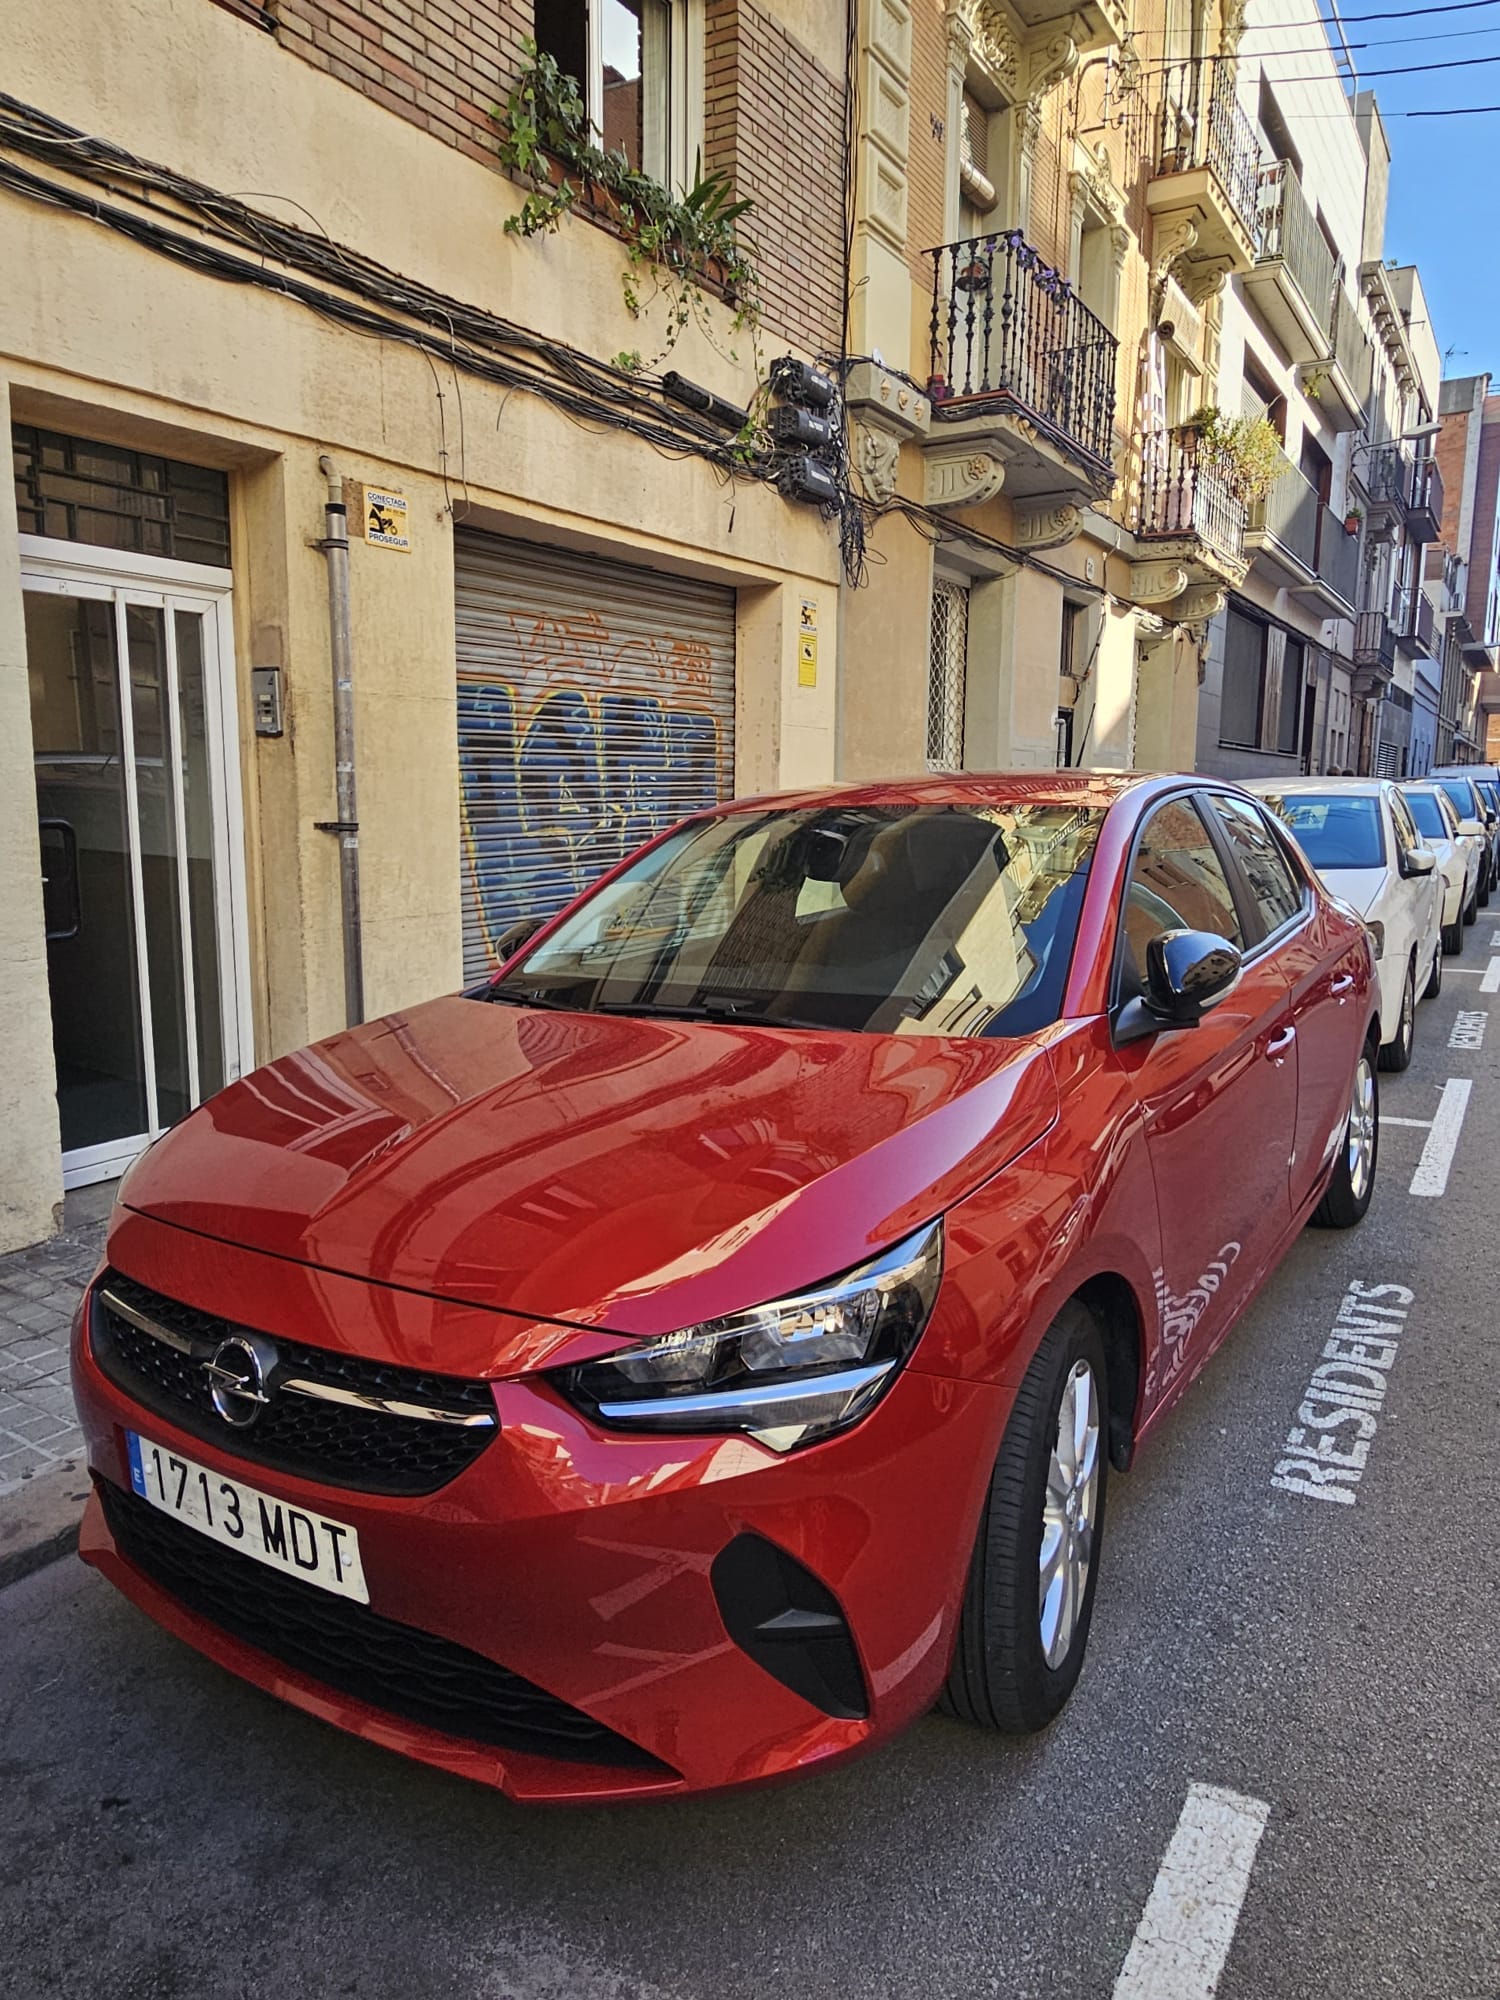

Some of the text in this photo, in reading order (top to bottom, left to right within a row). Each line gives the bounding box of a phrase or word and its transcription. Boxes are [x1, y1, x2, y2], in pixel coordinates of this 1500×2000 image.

[367, 492, 406, 506] CONECTADA
[368, 532, 408, 547] PROSEGUR
[1270, 1279, 1416, 1505] RESIDENTS
[133, 1467, 142, 1484] E
[152, 1448, 347, 1583] 1713 MDT
